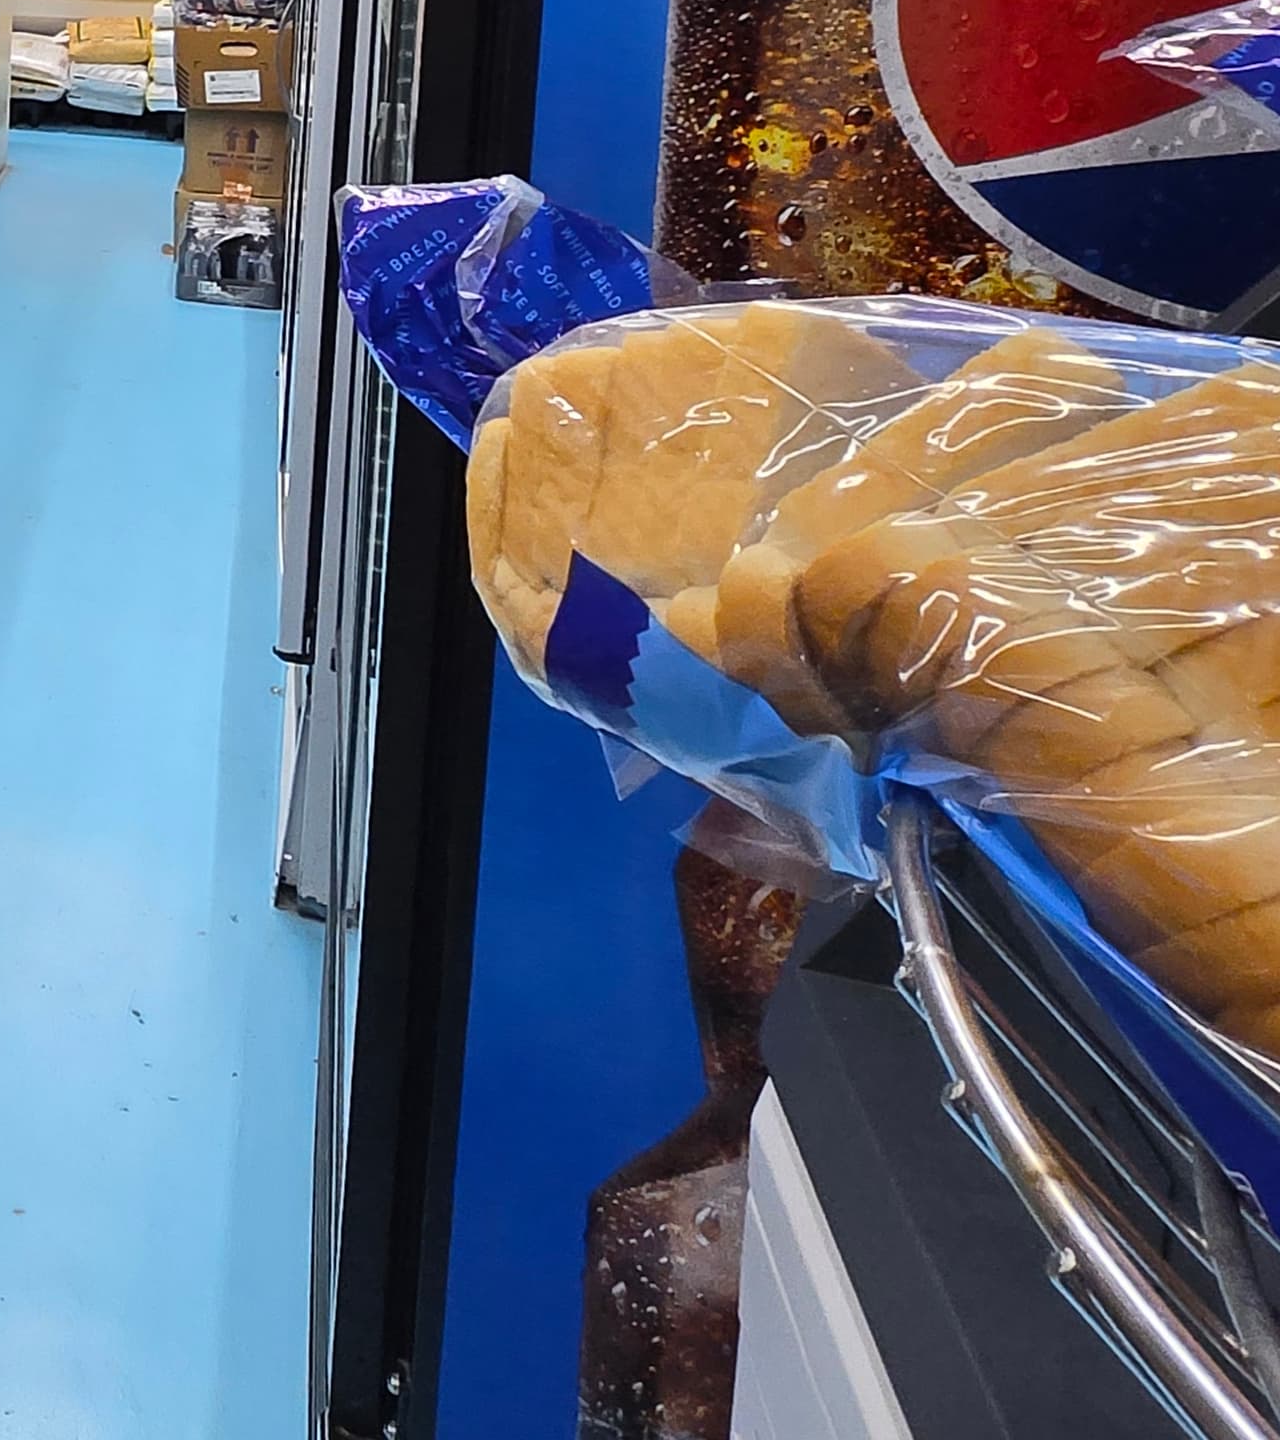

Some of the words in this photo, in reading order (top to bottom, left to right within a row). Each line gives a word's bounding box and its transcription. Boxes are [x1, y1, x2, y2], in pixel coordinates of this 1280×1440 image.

[388, 228, 448, 274] BREAD
[559, 225, 595, 268] WHITE
[587, 268, 623, 310] BREAD
[535, 262, 571, 298] SOFT
